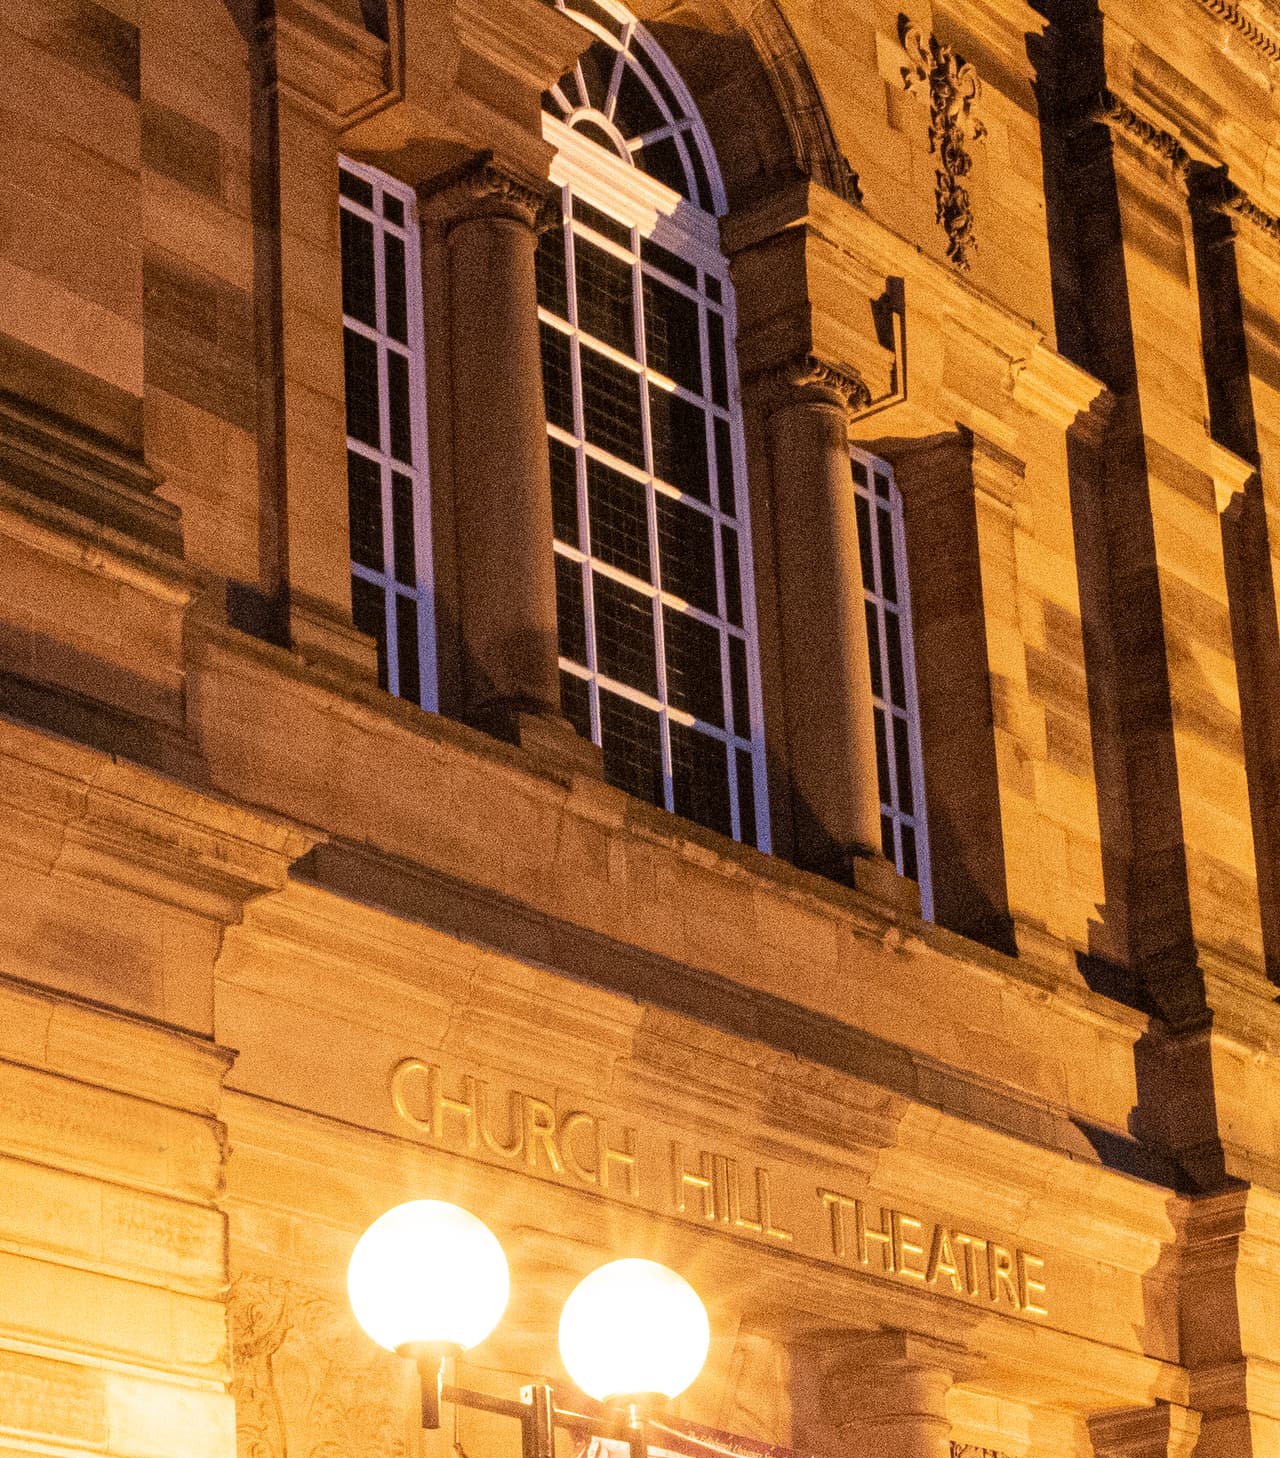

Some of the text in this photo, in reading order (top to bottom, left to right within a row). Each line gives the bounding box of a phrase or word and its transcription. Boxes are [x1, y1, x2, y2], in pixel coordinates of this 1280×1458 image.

[388, 1056, 1049, 1316] CHURCH HILL THEATRE
